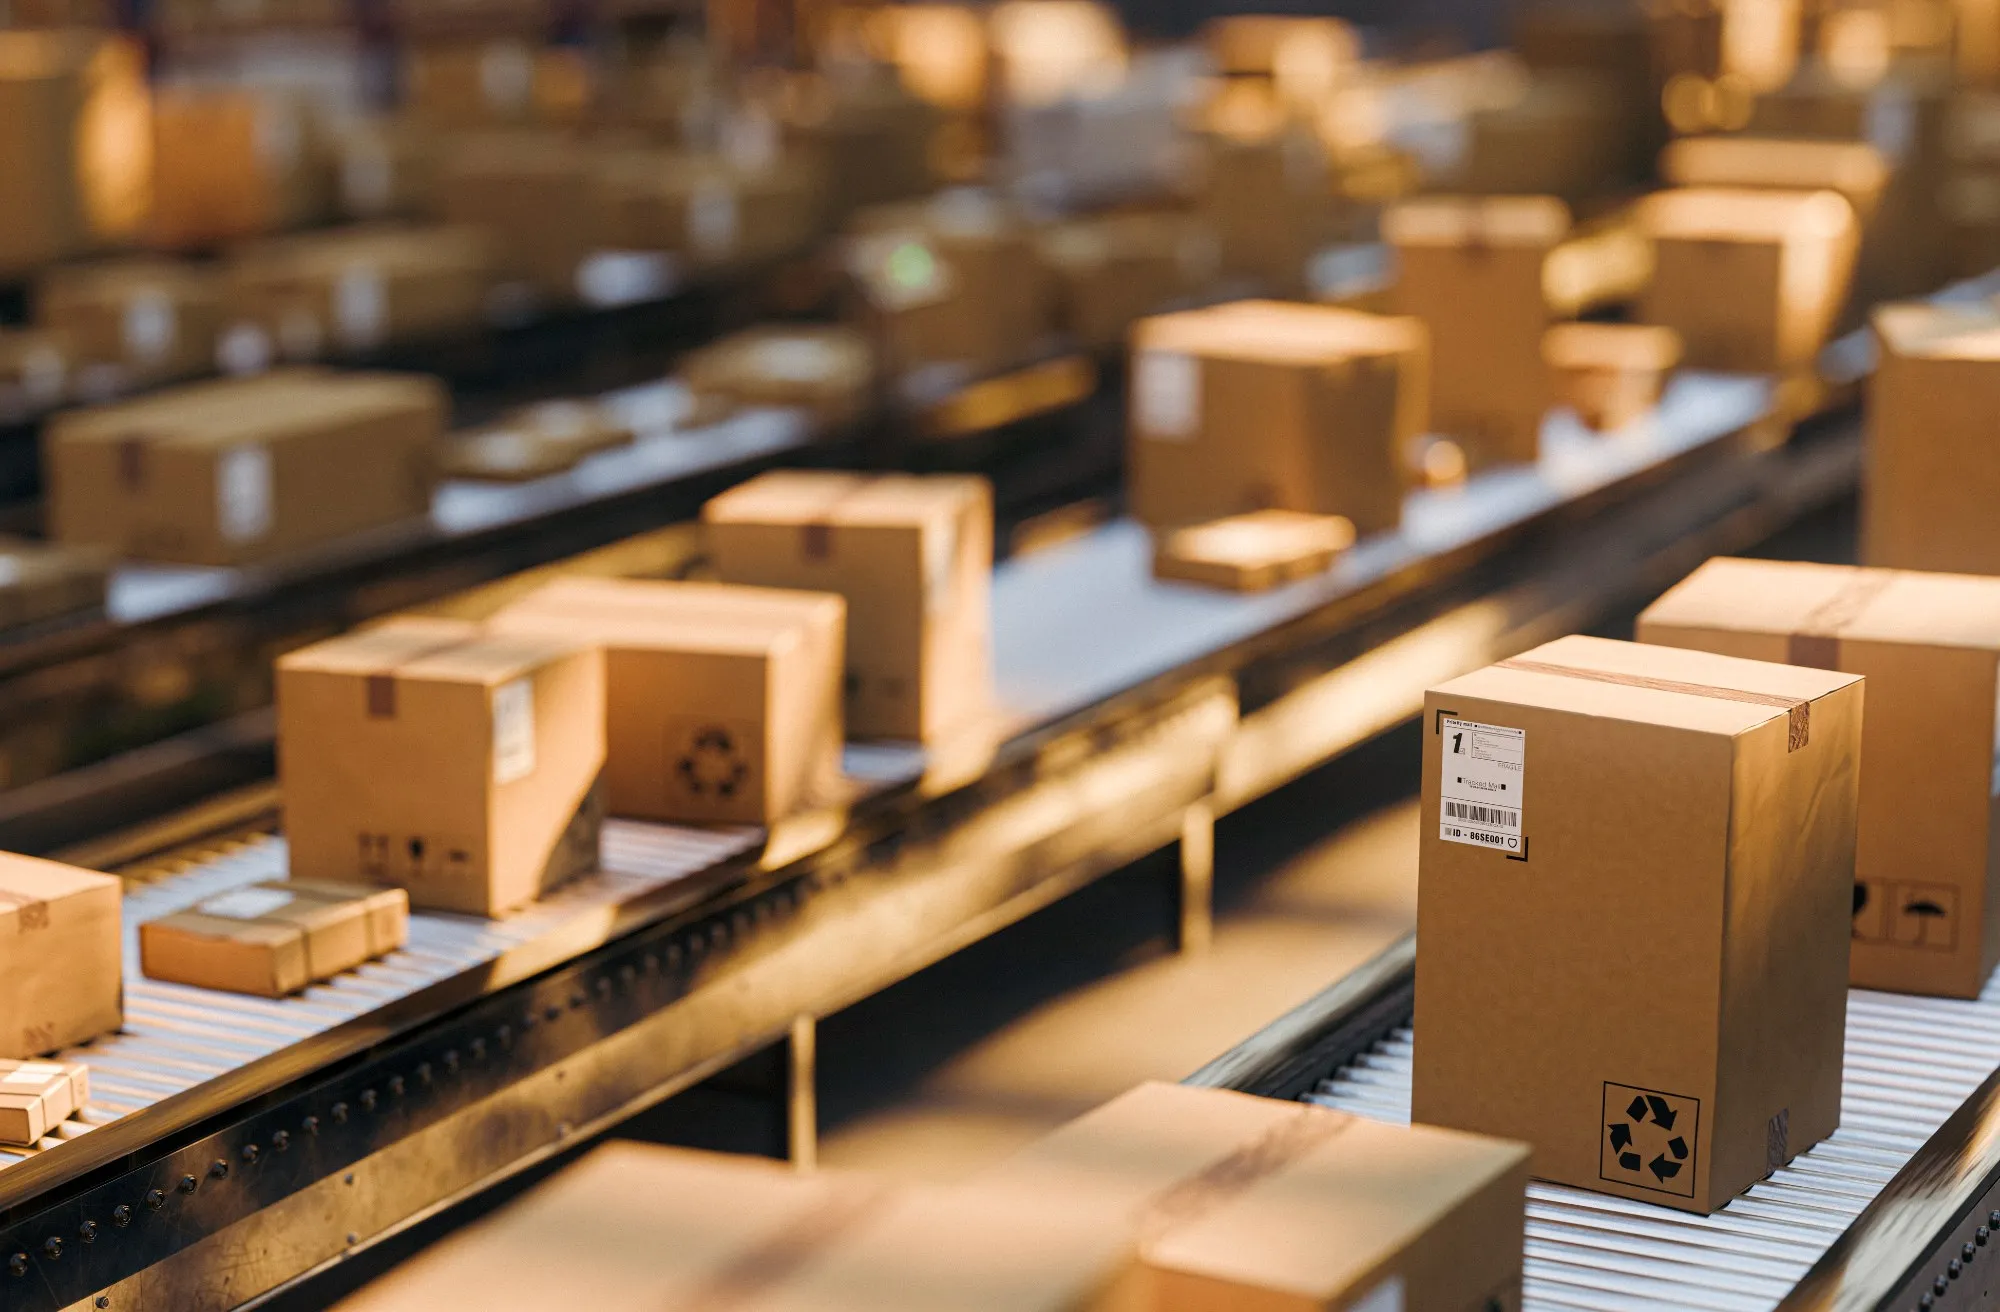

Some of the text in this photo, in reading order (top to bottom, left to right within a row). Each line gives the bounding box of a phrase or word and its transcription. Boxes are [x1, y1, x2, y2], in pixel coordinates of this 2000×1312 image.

[1453, 732, 1463, 753] 1
[1453, 828, 1461, 837] ID
[1470, 831, 1504, 845] 86SE001
